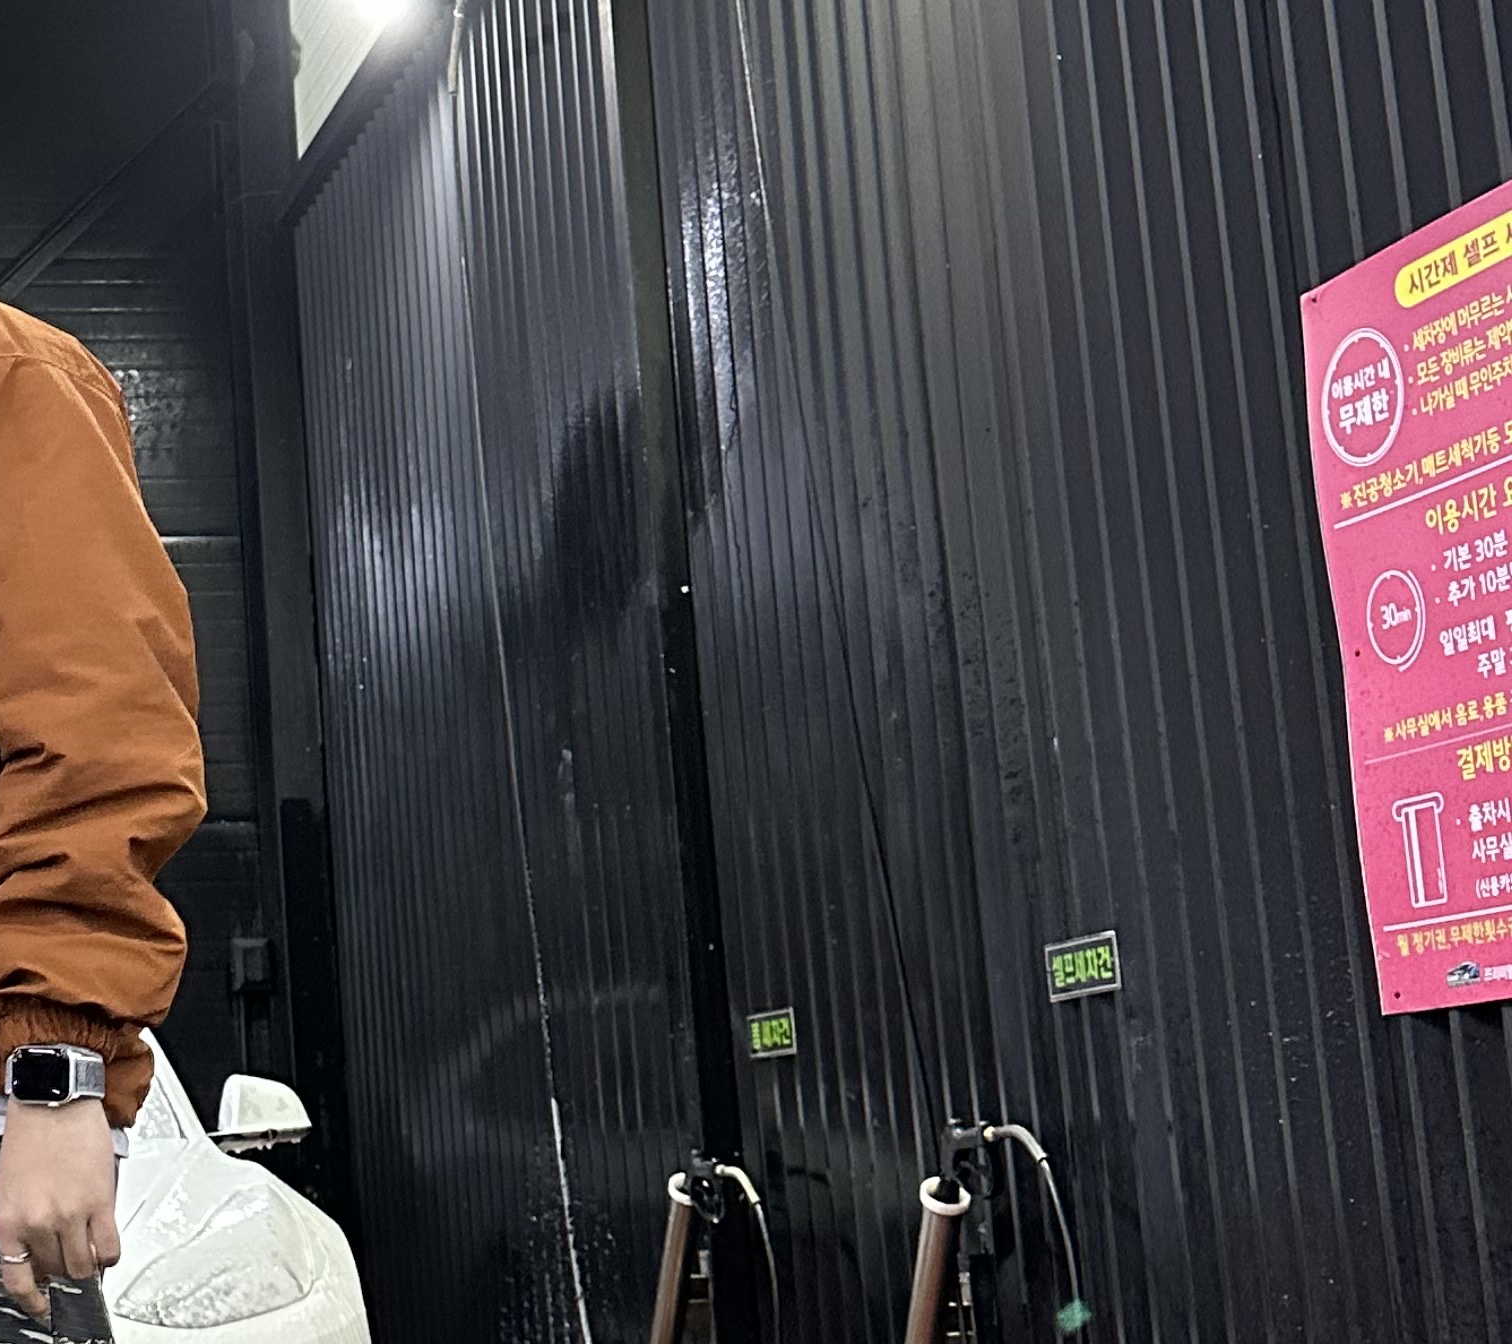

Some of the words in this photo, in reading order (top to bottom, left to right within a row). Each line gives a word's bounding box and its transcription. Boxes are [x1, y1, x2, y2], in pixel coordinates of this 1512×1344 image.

[1409, 249, 1458, 294] 시간제
[1463, 230, 1500, 268] 셀프
[1412, 311, 1458, 351] 세차장에
[1457, 292, 1504, 329] 머무르는
[1331, 364, 1376, 399] 이용시간
[1377, 357, 1391, 379] 내
[1416, 356, 1441, 385] 모든
[1440, 336, 1486, 376] 장비류는
[1339, 387, 1390, 435] 무제한
[1425, 483, 1497, 535] 이용시간
[1442, 543, 1472, 571] 기본
[1474, 529, 1508, 563] 30분
[1447, 575, 1476, 607] 추가
[1478, 562, 1512, 595] 10분
[1439, 614, 1496, 656] 일일최대
[1477, 646, 1507, 679] 주말
[1456, 736, 1512, 781] 결제방
[1468, 797, 1511, 832] 출차시
[1476, 873, 1512, 899] (신용카
